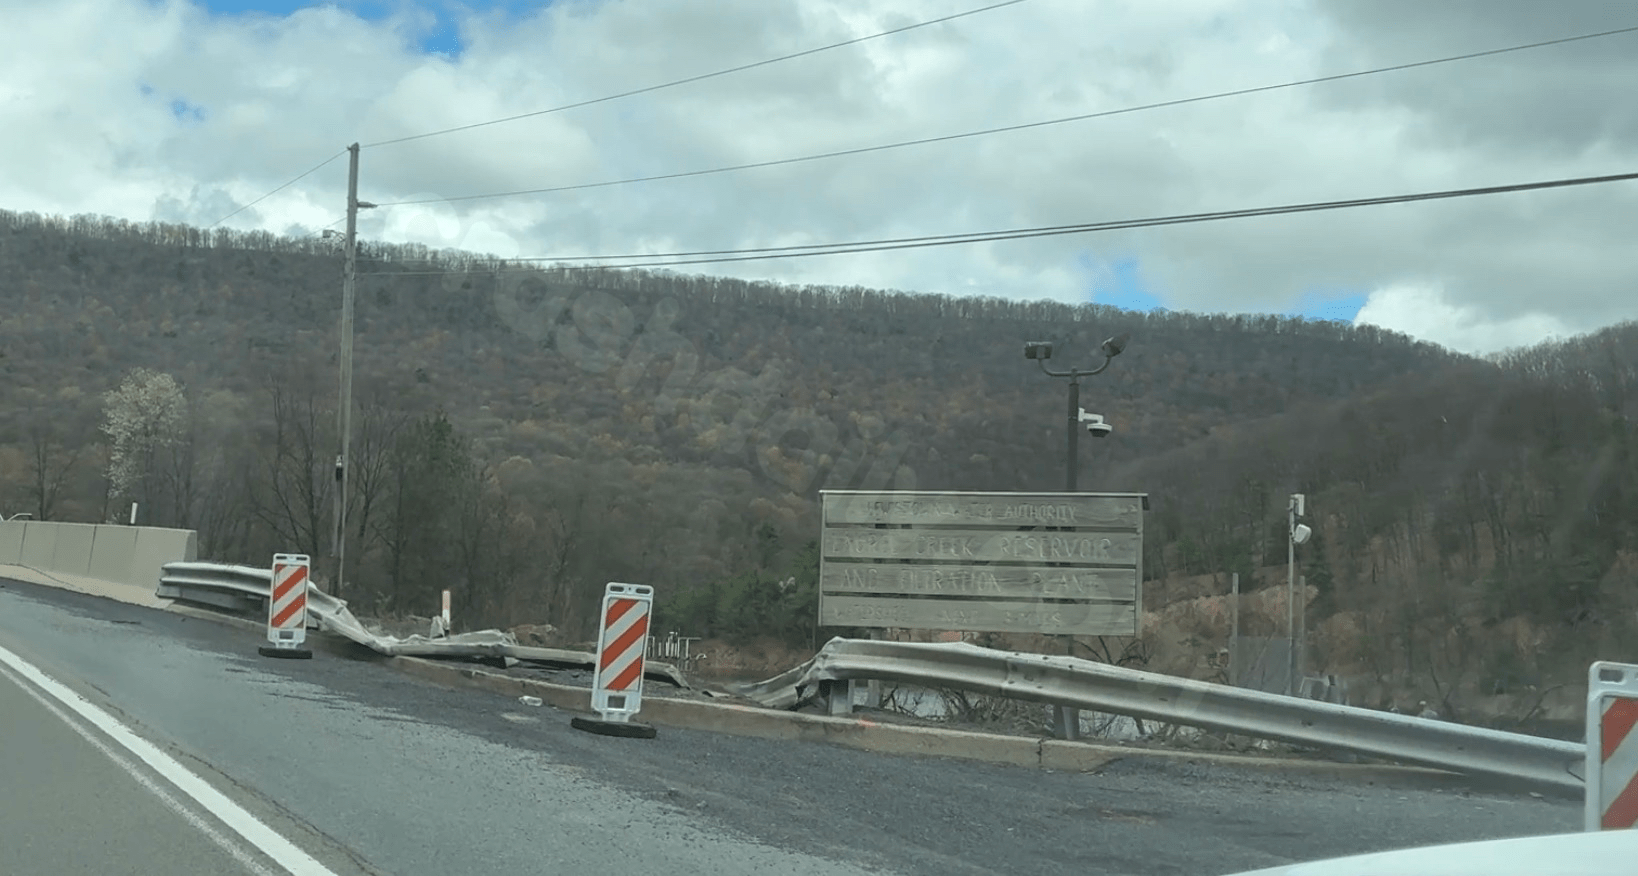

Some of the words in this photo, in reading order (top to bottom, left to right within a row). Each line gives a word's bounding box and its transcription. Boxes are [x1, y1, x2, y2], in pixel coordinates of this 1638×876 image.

[1004, 502, 1078, 522] AUTHORITY
[916, 535, 974, 557] CREEK
[1000, 535, 1112, 560] RESERVOIR
[840, 567, 878, 590] AND
[901, 568, 1001, 593] FILTRATION
[1032, 572, 1099, 595] PLANT
